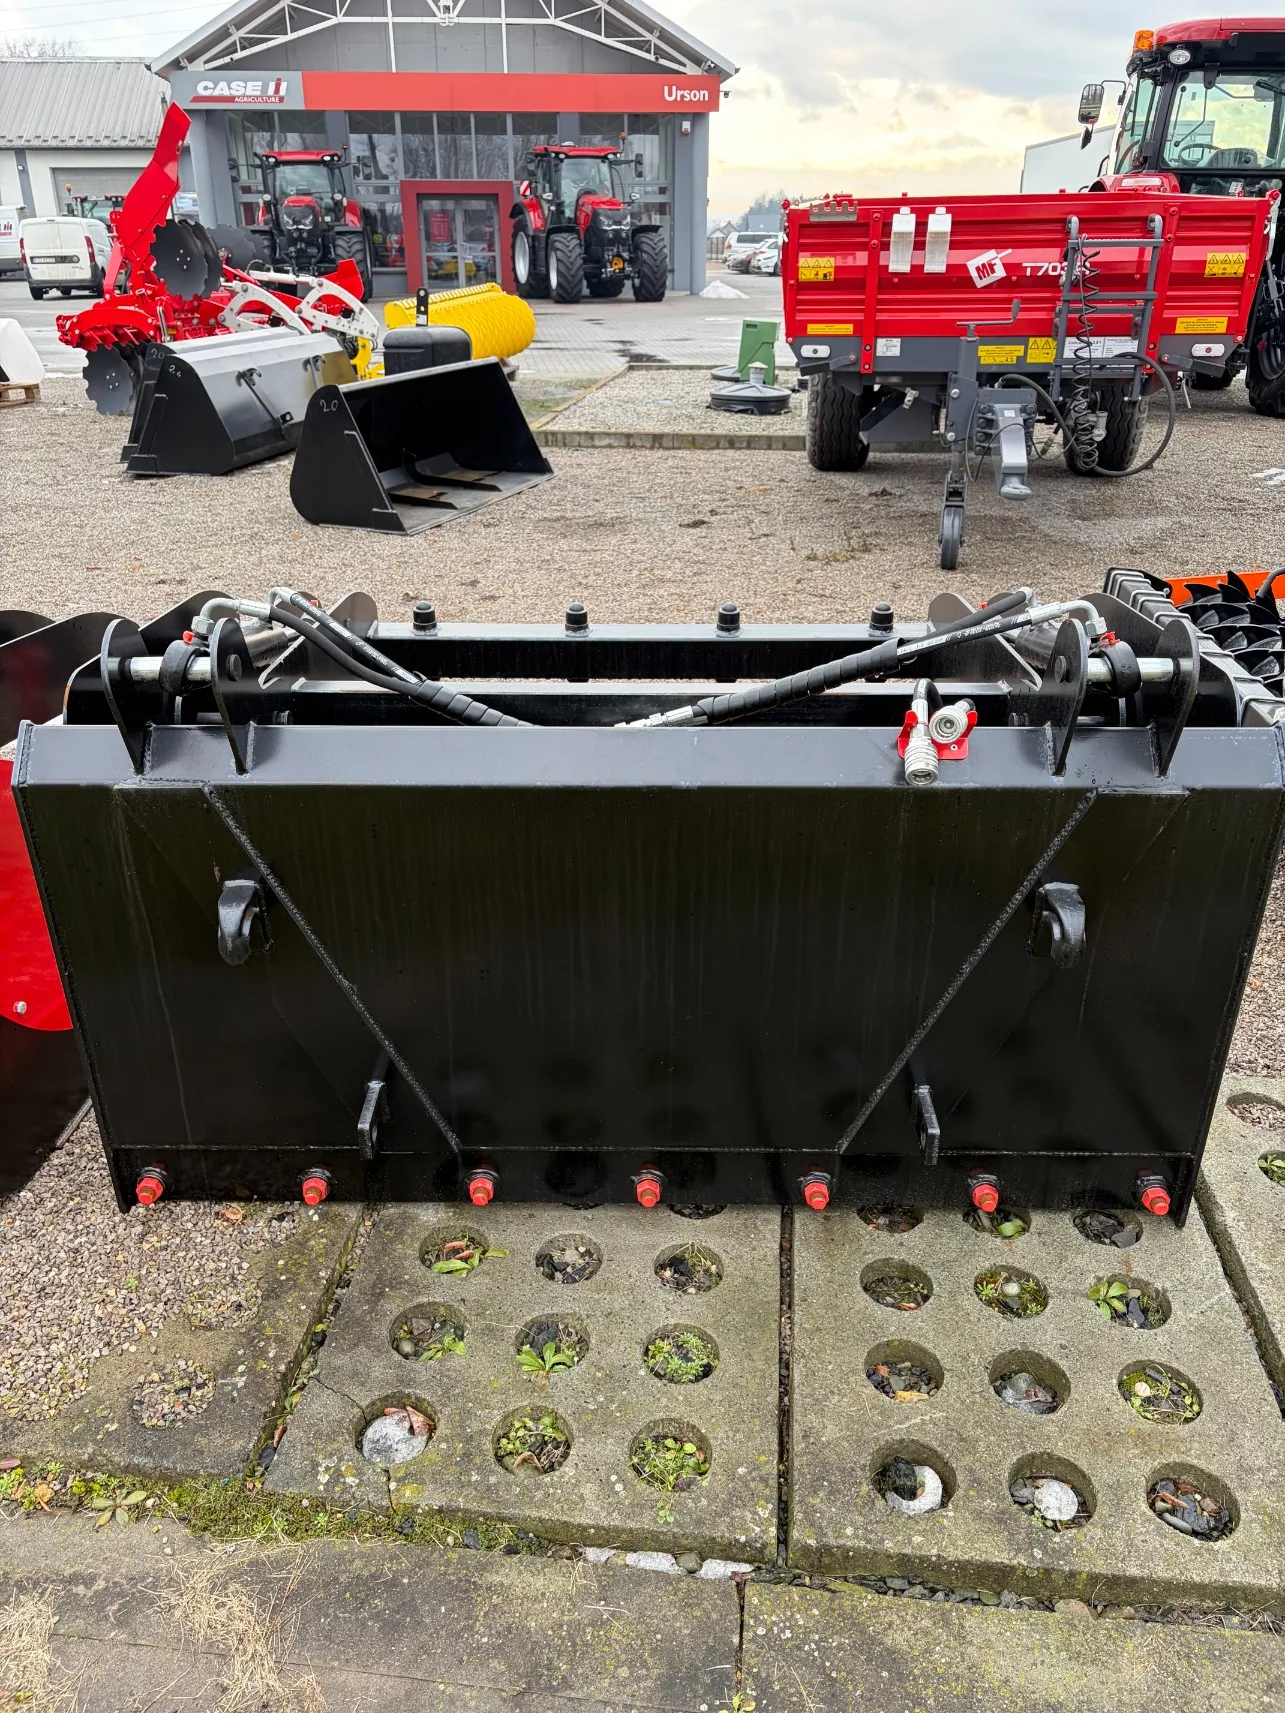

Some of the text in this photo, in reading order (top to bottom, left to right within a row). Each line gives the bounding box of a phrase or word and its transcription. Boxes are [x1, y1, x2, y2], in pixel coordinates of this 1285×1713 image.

[196, 81, 262, 95] CASE
[664, 86, 709, 101] Urson
[974, 259, 998, 280] MF
[320, 400, 338, 412] 2.0
